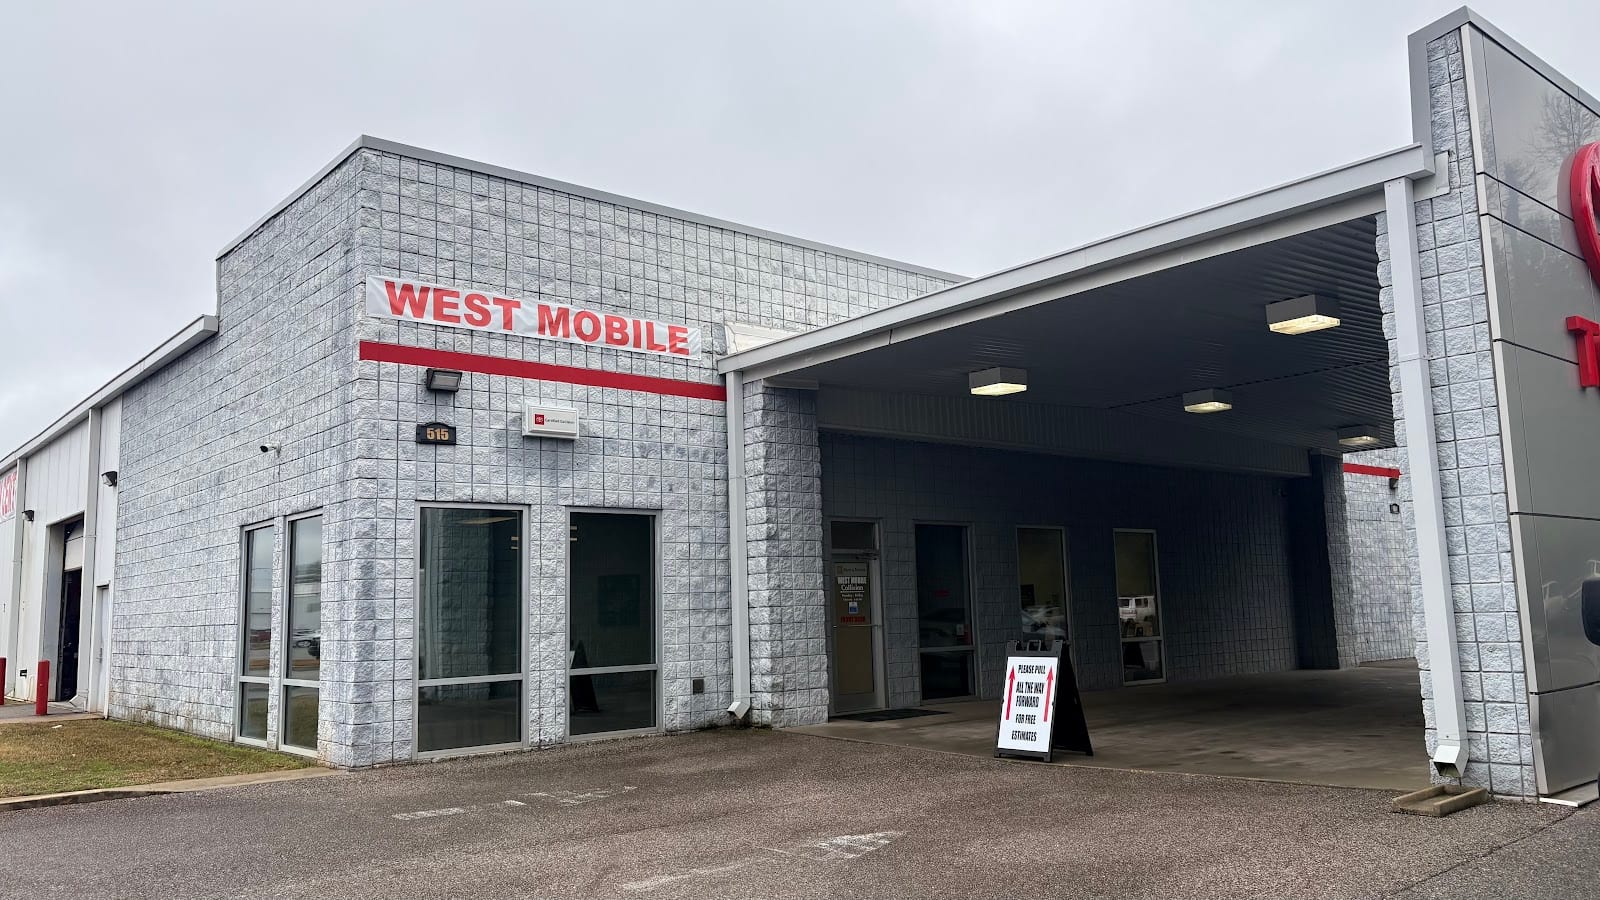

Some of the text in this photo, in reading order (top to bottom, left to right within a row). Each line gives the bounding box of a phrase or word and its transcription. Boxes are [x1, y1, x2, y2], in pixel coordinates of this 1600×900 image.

[384, 280, 690, 356] WEST MOBILE
[426, 427, 449, 441] 515
[1018, 664, 1046, 674] PLEASE PULL
[1024, 682, 1034, 694] THE
[1034, 682, 1044, 694] WAY
[1016, 696, 1039, 707] FORWARD
[1016, 714, 1036, 724] FOR FREE
[1012, 730, 1037, 742] ESTIMATES
